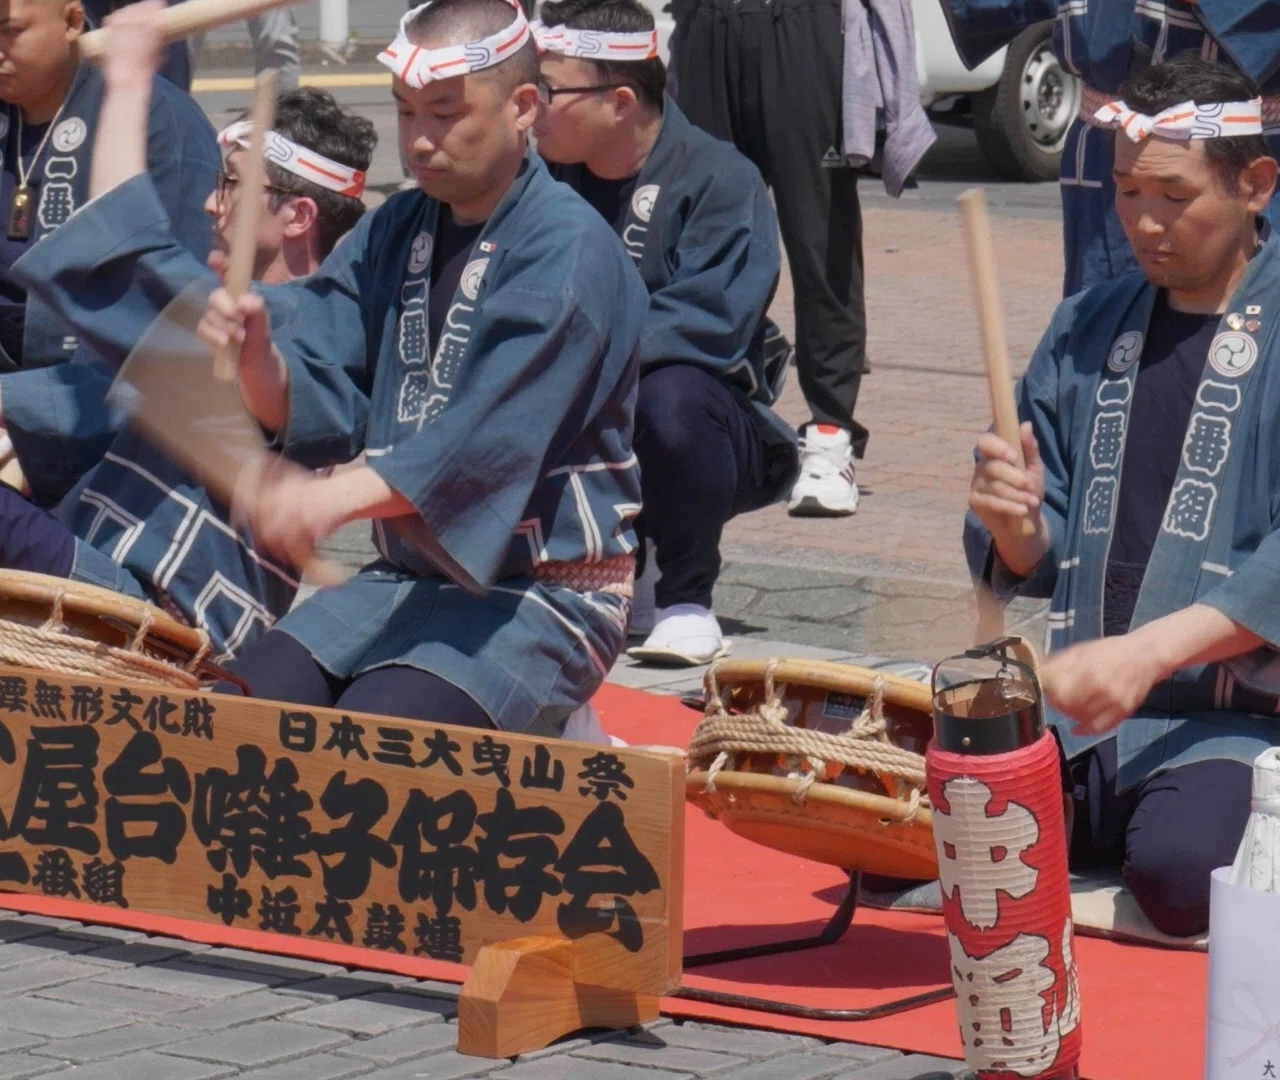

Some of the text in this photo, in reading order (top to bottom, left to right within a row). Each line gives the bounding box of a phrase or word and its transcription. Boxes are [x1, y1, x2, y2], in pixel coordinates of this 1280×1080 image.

[37, 156, 78, 240] 一番
[1083, 377, 1132, 534] 一番組
[1163, 379, 1241, 541] 一番組
[279, 710, 634, 801] 日本三大曳山祭
